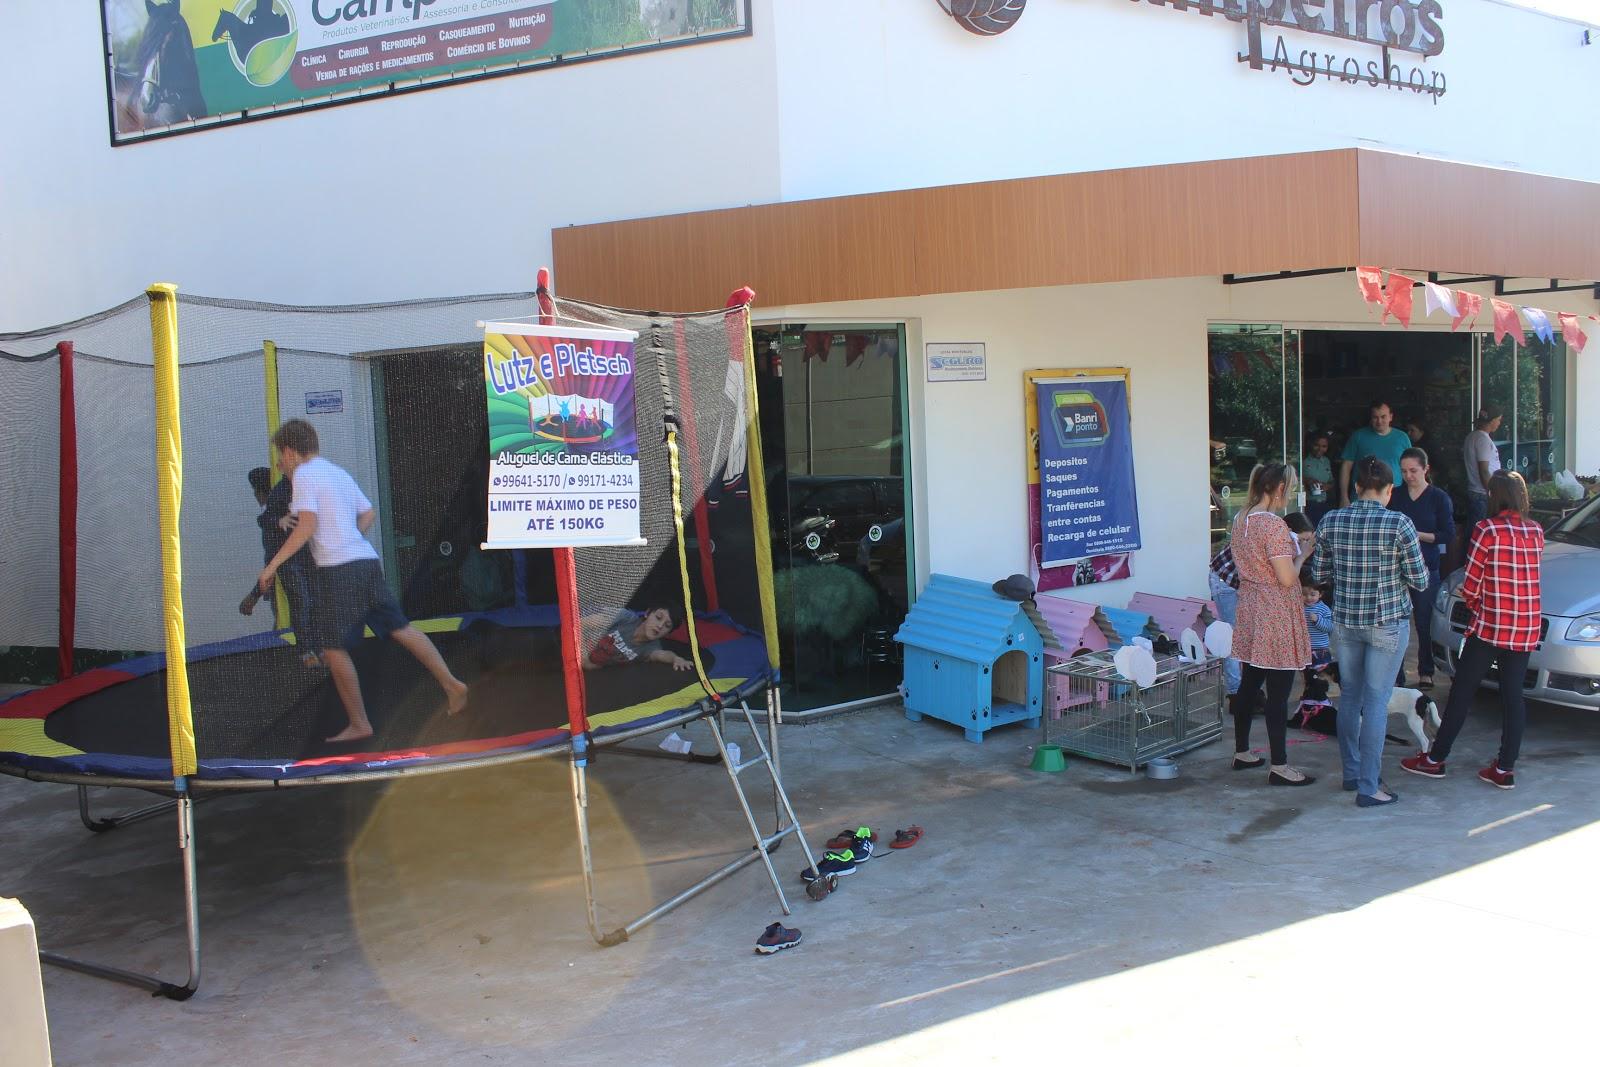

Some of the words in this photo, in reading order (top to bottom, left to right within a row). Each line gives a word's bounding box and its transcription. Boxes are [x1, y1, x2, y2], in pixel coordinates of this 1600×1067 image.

[322, 25, 359, 40] Produtos
[423, 4, 469, 19] Assessoria
[301, 54, 327, 67] CLÍNICA
[338, 46, 369, 59] CIRURGIA
[381, 35, 426, 52] REPRODUÇÃO
[439, 23, 496, 41] CASQUEAMENTO
[508, 13, 546, 29] NUTRIÇÃO
[315, 70, 338, 81] VENDA
[339, 68, 348, 77] DE
[349, 62, 374, 76] RAÇÕES
[375, 62, 380, 70] E
[382, 52, 434, 69] MEDICAMENTOS
[447, 41, 485, 58] COMÉRCIO
[487, 41, 496, 51] DE
[498, 35, 531, 49] BOVINOS
[1271, 35, 1447, 105] Agroshop
[487, 349, 537, 395] Lutz
[554, 343, 632, 376] Pletsch
[1074, 412, 1098, 424] Banri
[1075, 422, 1098, 434] ponto
[497, 451, 539, 468] Aluguel
[541, 452, 555, 465] de
[557, 452, 588, 465] Cama
[590, 450, 633, 465] Elástica
[1044, 457, 1088, 469] Depositos
[502, 474, 561, 488] 99641-5170
[577, 474, 633, 487] 99171-4234
[1045, 473, 1078, 484] Saques
[1046, 486, 1099, 499] Pagamentos
[490, 500, 532, 512] LIMITE
[536, 497, 585, 511] MÁXIMO
[588, 499, 604, 510] DE
[607, 498, 637, 510] PESO
[526, 516, 555, 531] ATÉ
[559, 517, 605, 530] 150KG
[1047, 517, 1071, 528] entre
[1073, 514, 1102, 525] contas
[1047, 530, 1085, 543] Recarga
[1087, 529, 1097, 538] de
[1098, 525, 1131, 536] celular
